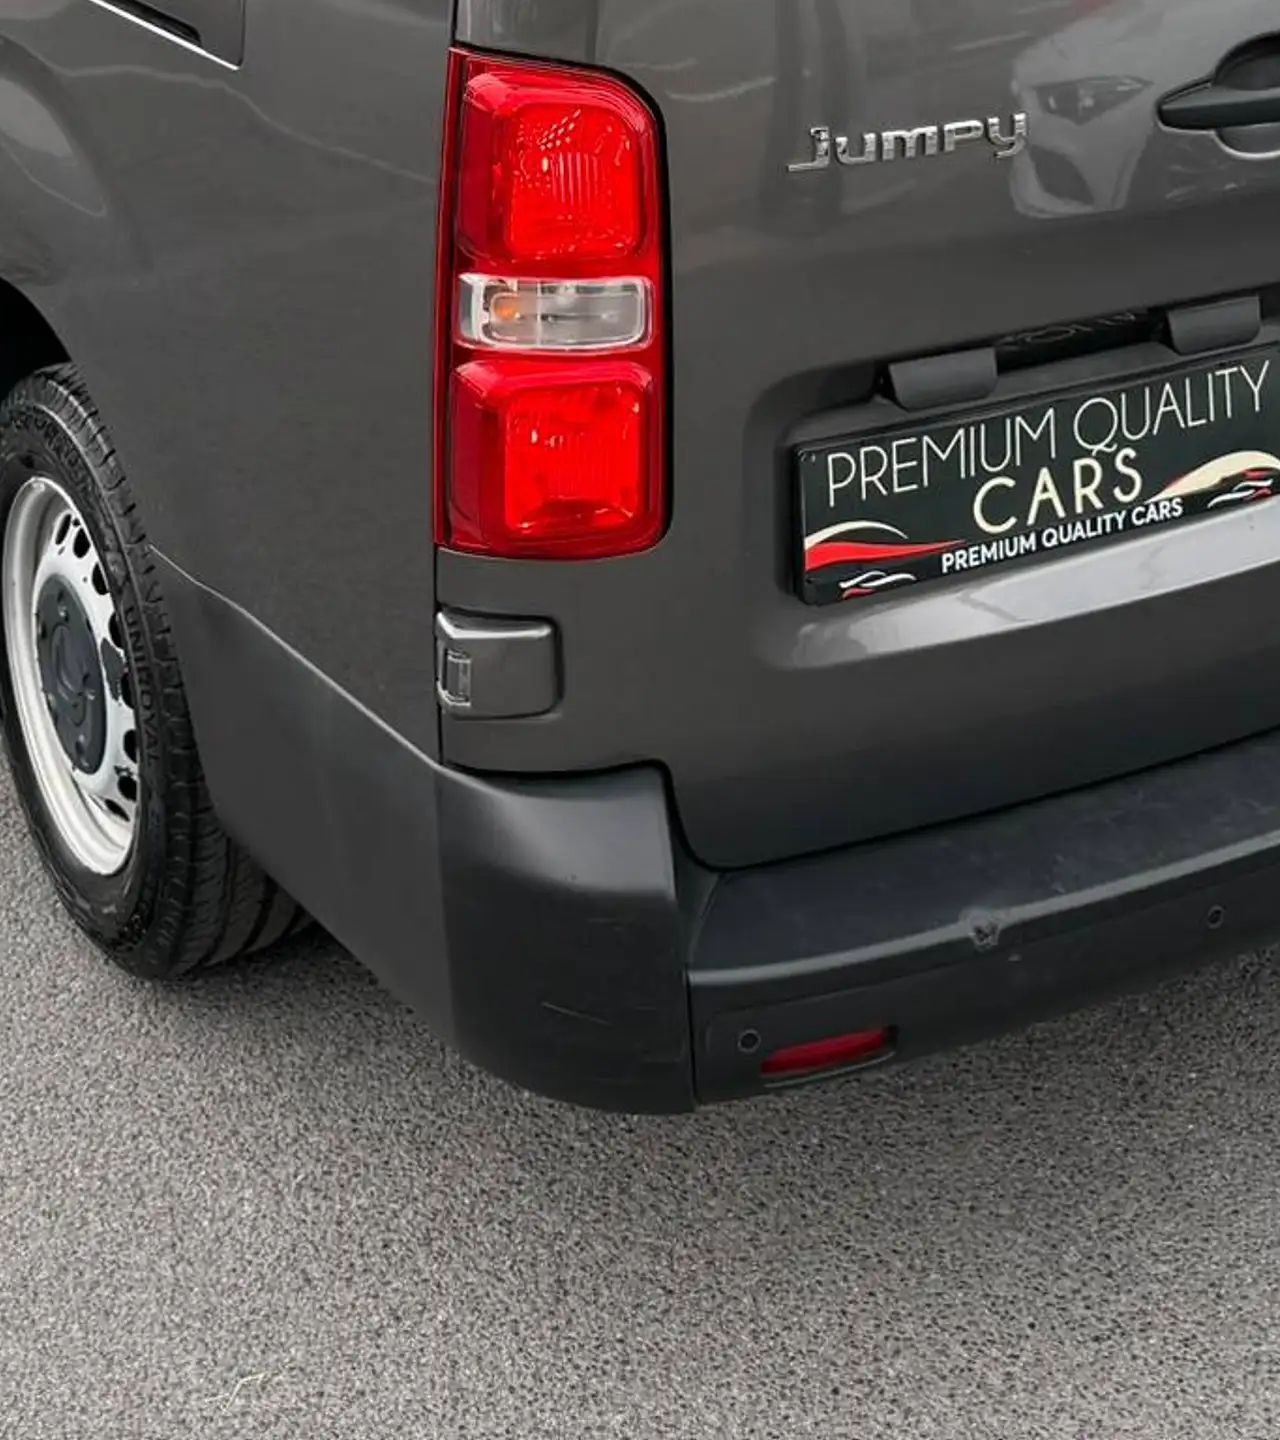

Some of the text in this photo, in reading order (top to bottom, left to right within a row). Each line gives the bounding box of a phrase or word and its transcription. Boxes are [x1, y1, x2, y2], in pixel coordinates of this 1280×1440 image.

[787, 113, 1026, 171] Jumpy
[827, 360, 1270, 508] PREMIUM QUALITY
[973, 447, 1142, 535] CARS
[941, 497, 1183, 574] PREMIUM QUALITY CARS
